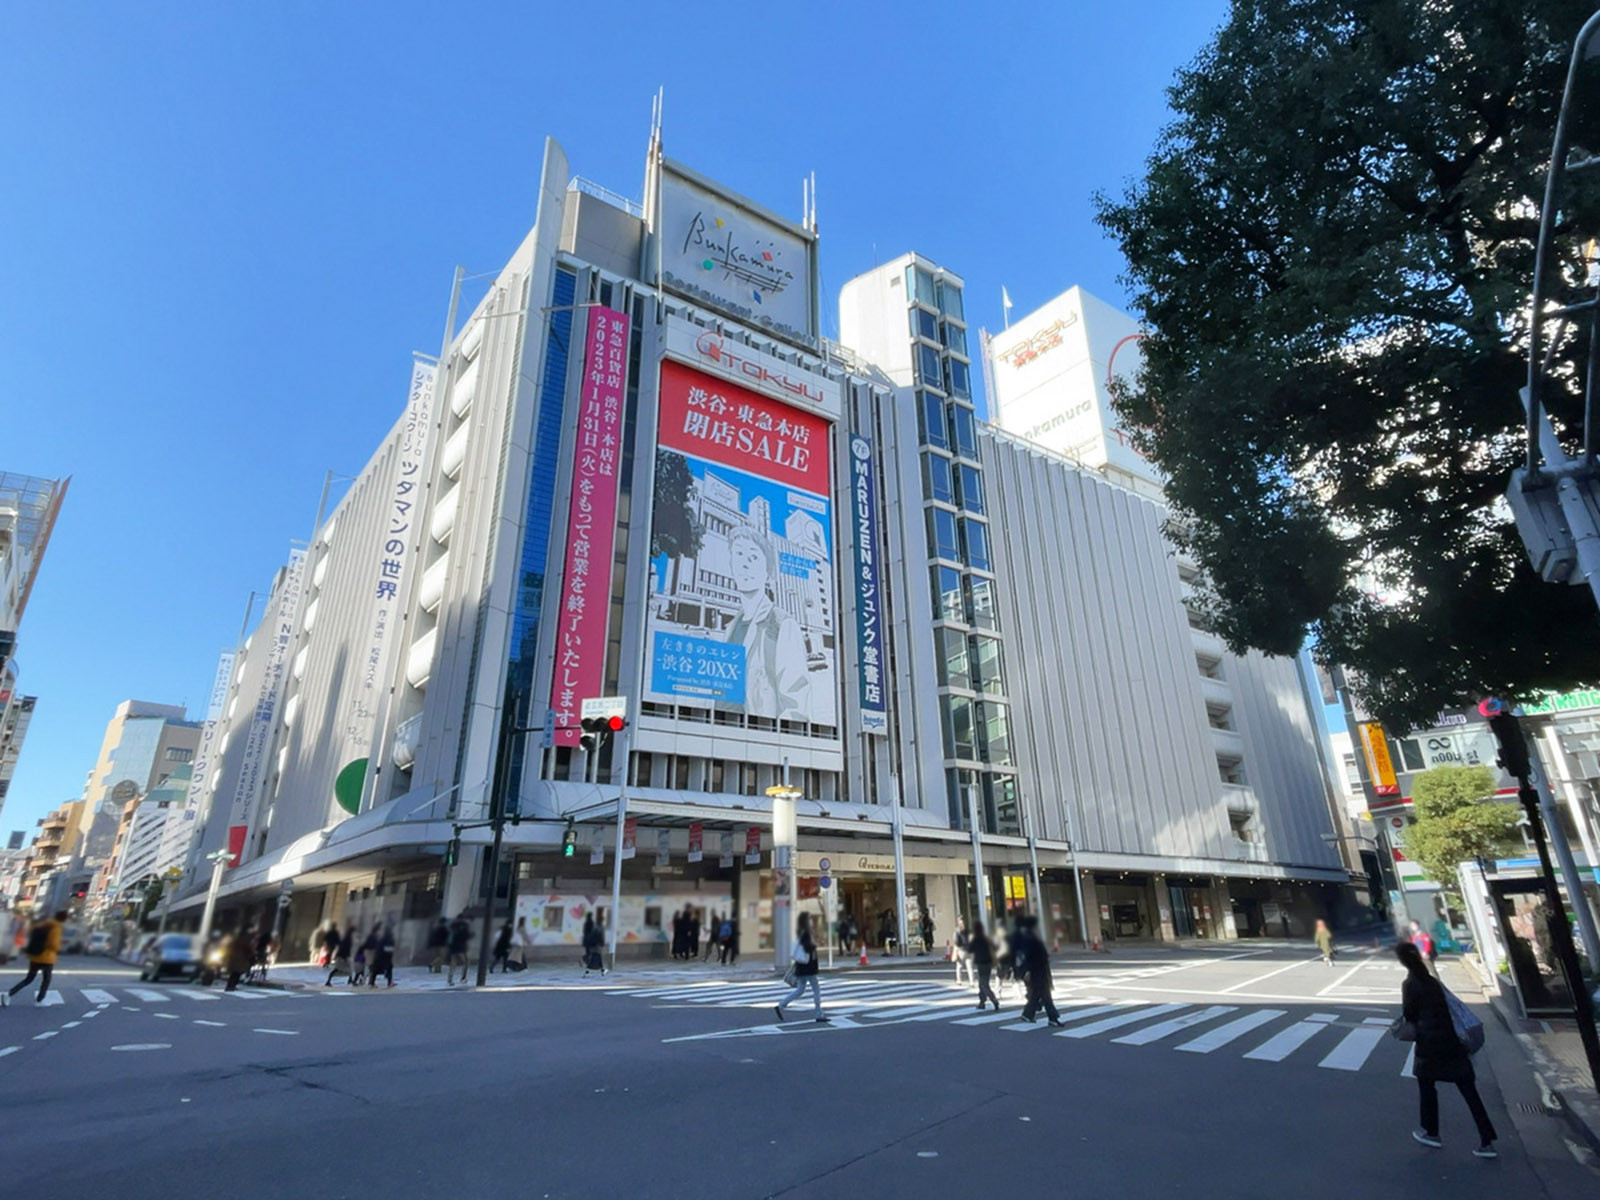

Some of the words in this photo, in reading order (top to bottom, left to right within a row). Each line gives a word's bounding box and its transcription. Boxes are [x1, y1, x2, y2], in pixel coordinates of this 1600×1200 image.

[607, 321, 625, 389] 東急百貨店
[721, 350, 824, 403] TOKYU
[683, 410, 810, 473] 閉店SALE
[687, 386, 811, 445] 渋谷・東急本店
[375, 459, 419, 602] ツダマンの世界
[662, 638, 741, 660] 左ききのエレン
